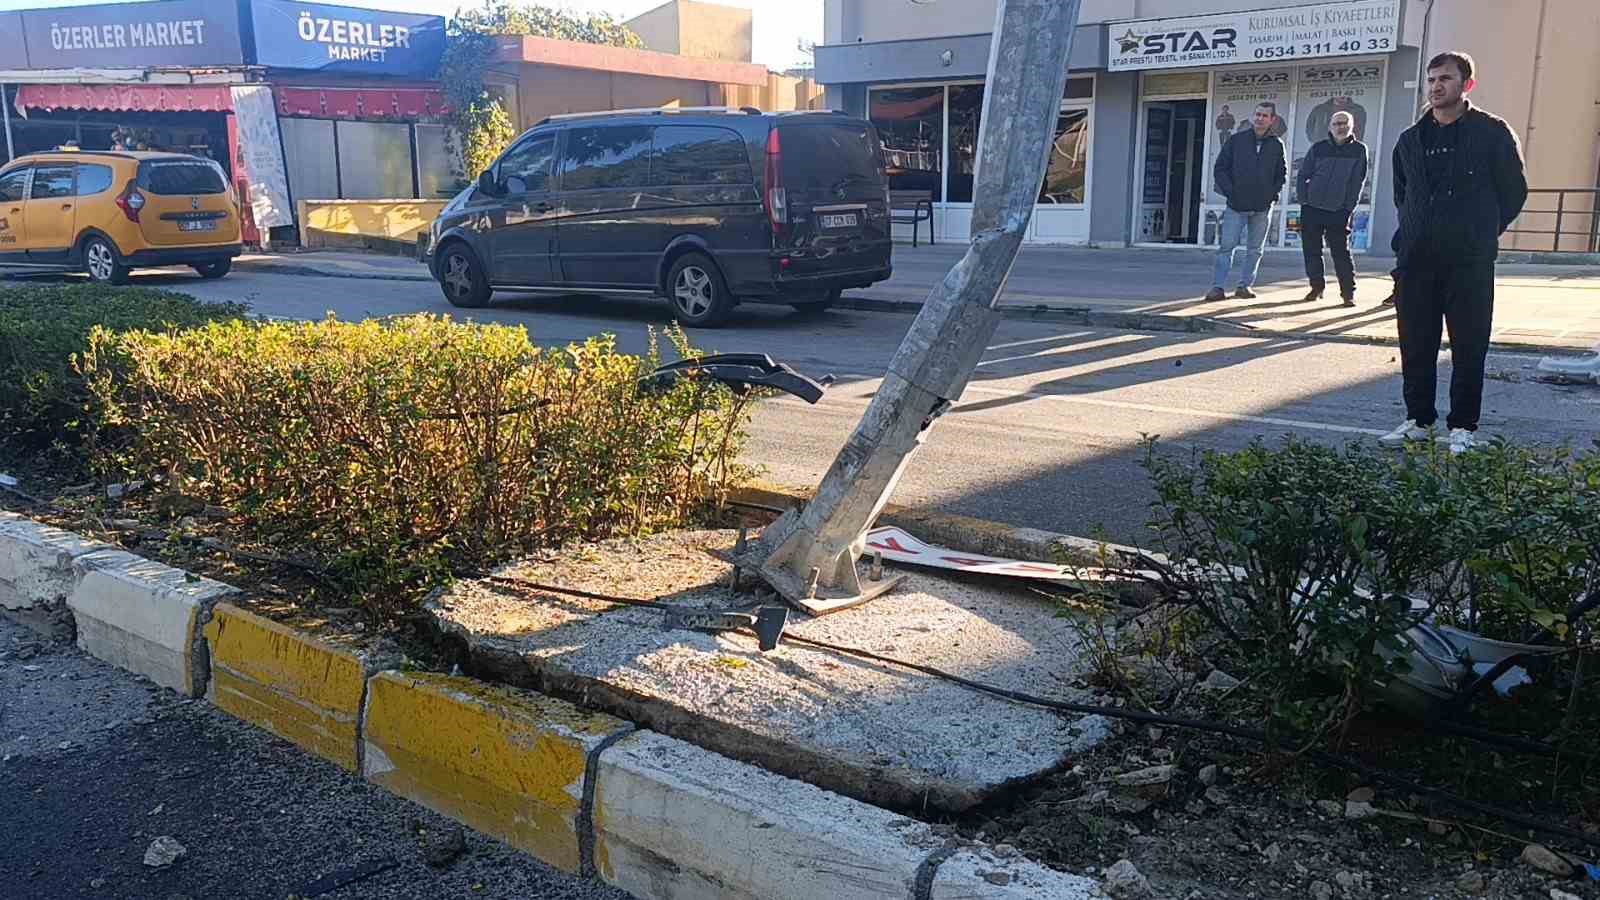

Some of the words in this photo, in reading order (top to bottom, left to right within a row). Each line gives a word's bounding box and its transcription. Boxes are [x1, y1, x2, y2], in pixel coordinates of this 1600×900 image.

[298, 11, 411, 49] ÖZERLER
[1248, 13, 1306, 31] KURUMSAL
[50, 23, 127, 50] ÖZERLER
[130, 19, 205, 47] MARKET
[1143, 28, 1237, 55] STAR
[328, 45, 386, 62] MARKET
[1254, 45, 1296, 58] 0534
[1301, 42, 1331, 55] 311
[1338, 40, 1361, 52] 40
[1367, 38, 1390, 50] 33
[1112, 57, 1128, 66] STAR
[1234, 72, 1289, 83] STAR
[1320, 67, 1380, 78] STAR
